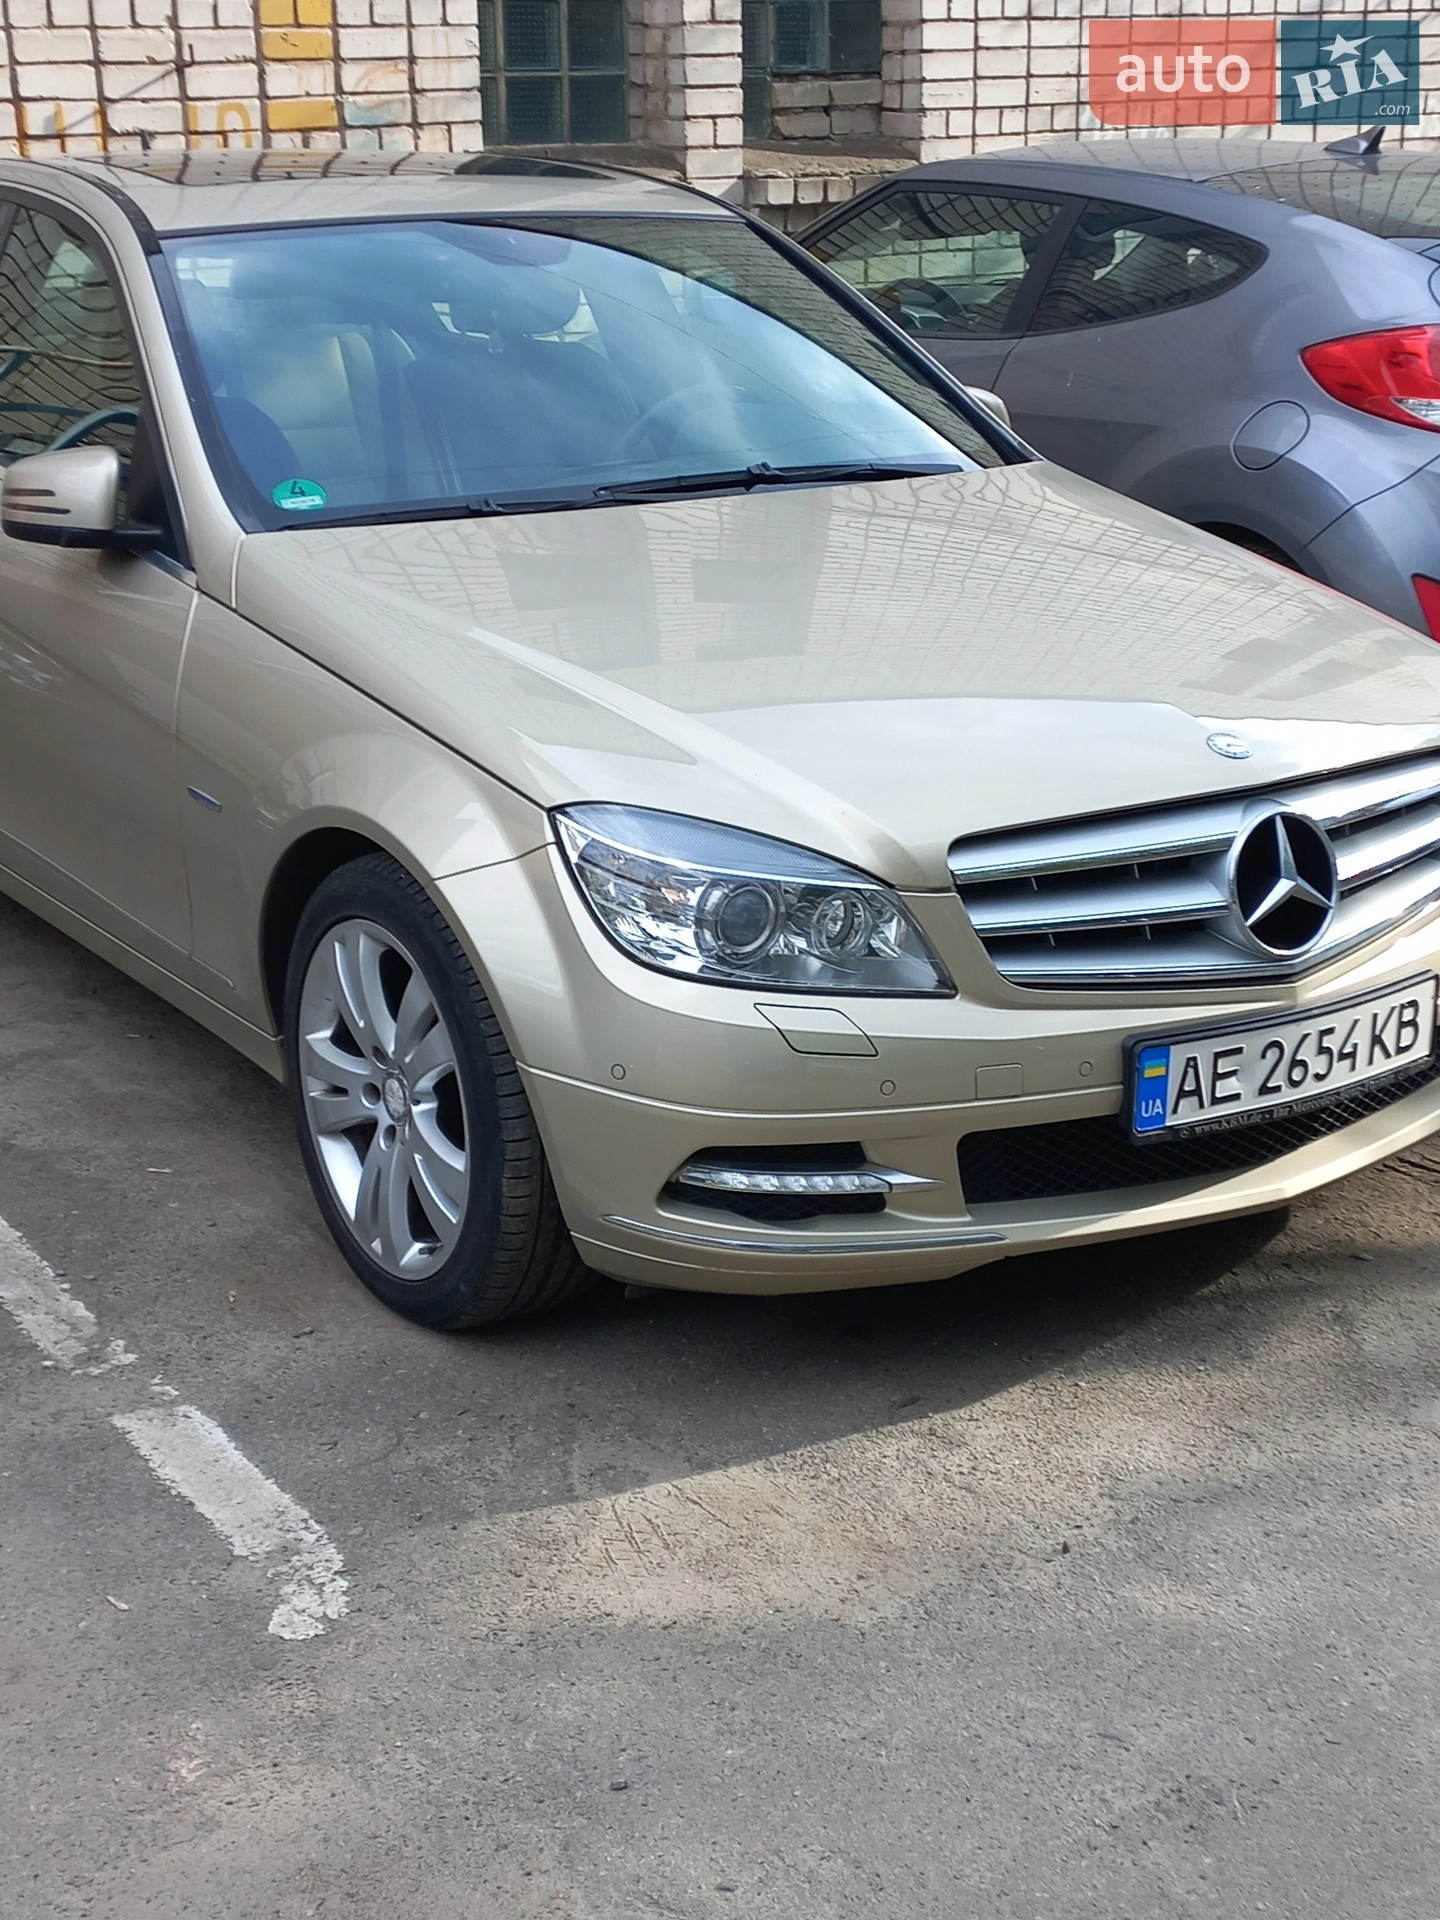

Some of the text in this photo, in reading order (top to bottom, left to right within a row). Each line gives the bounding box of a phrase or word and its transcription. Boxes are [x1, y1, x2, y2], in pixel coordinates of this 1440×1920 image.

[290, 480, 307, 497] 4
[1172, 997, 1420, 1115] AE 2654 KB
[1141, 1098, 1163, 1118] UA
